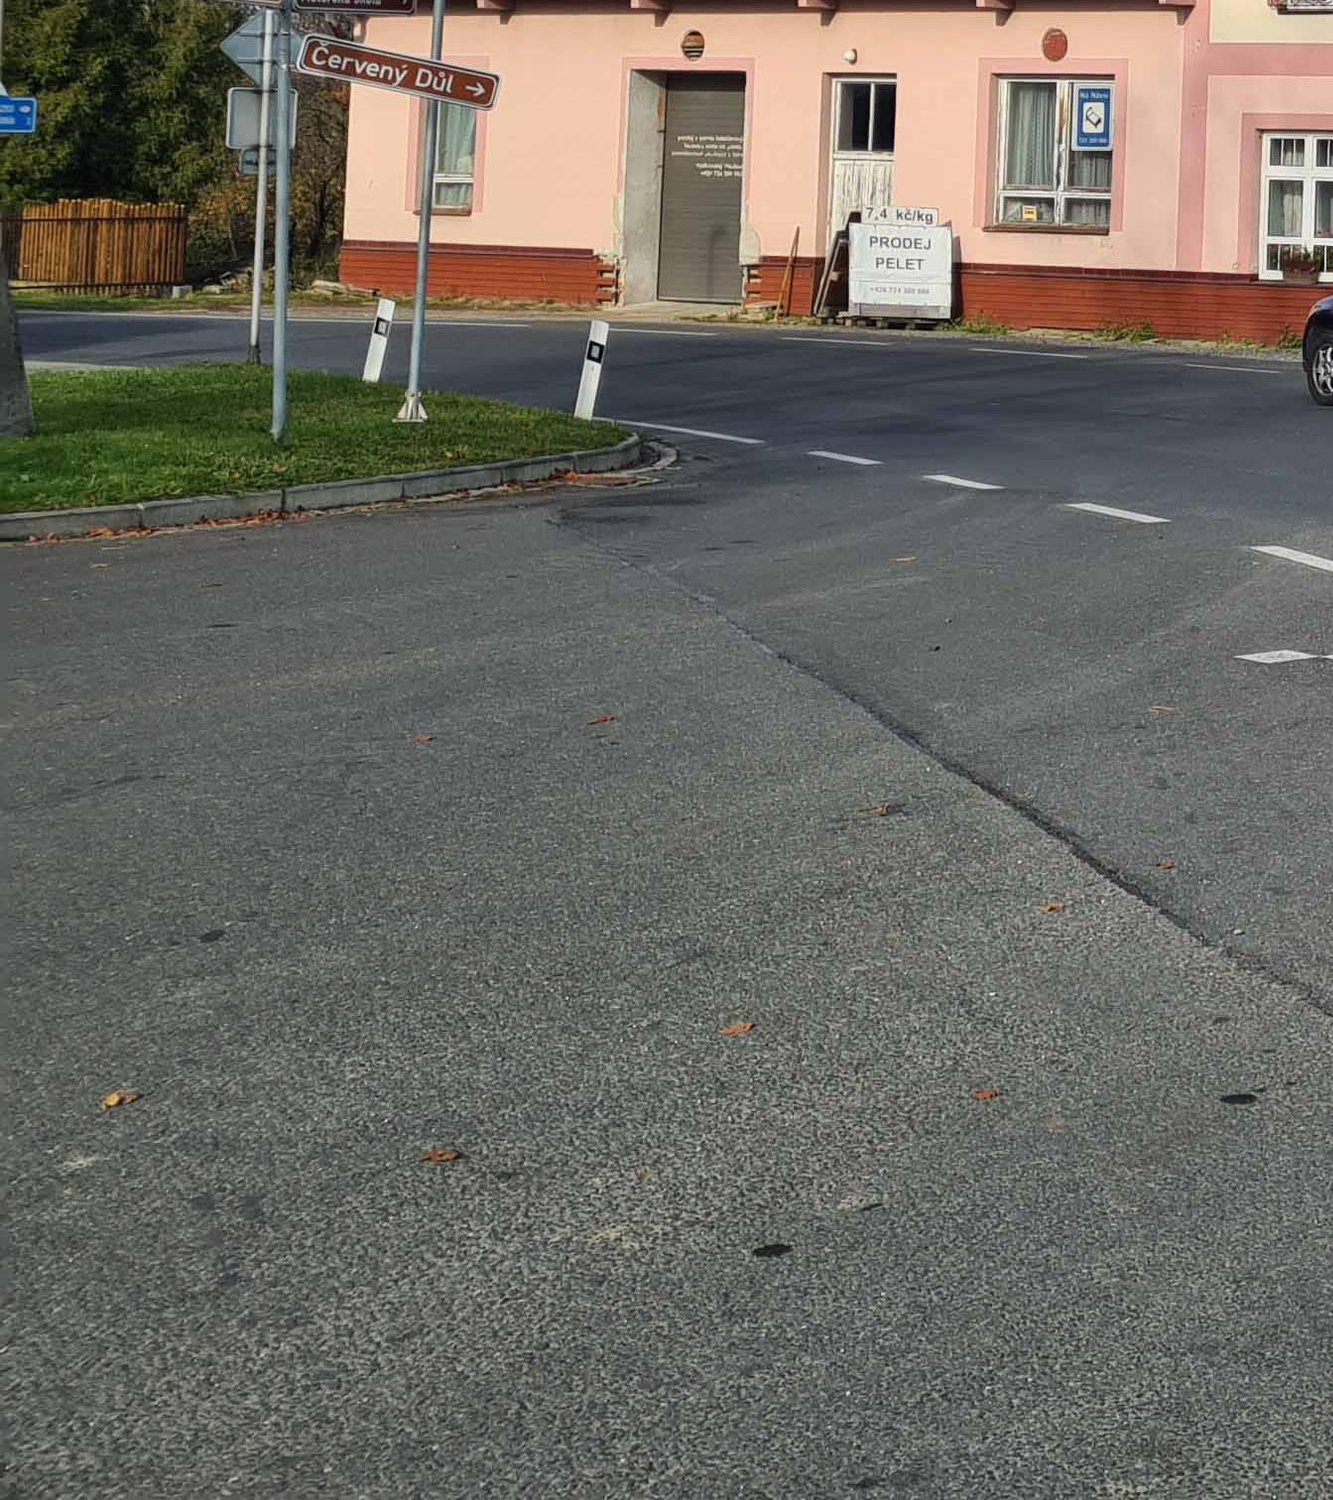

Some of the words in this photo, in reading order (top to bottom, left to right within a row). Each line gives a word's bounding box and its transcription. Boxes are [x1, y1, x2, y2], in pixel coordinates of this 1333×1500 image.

[310, 40, 407, 86] Červený
[414, 68, 453, 94] Důl
[869, 235, 932, 250] PRODEJ
[875, 257, 925, 271] PELET
